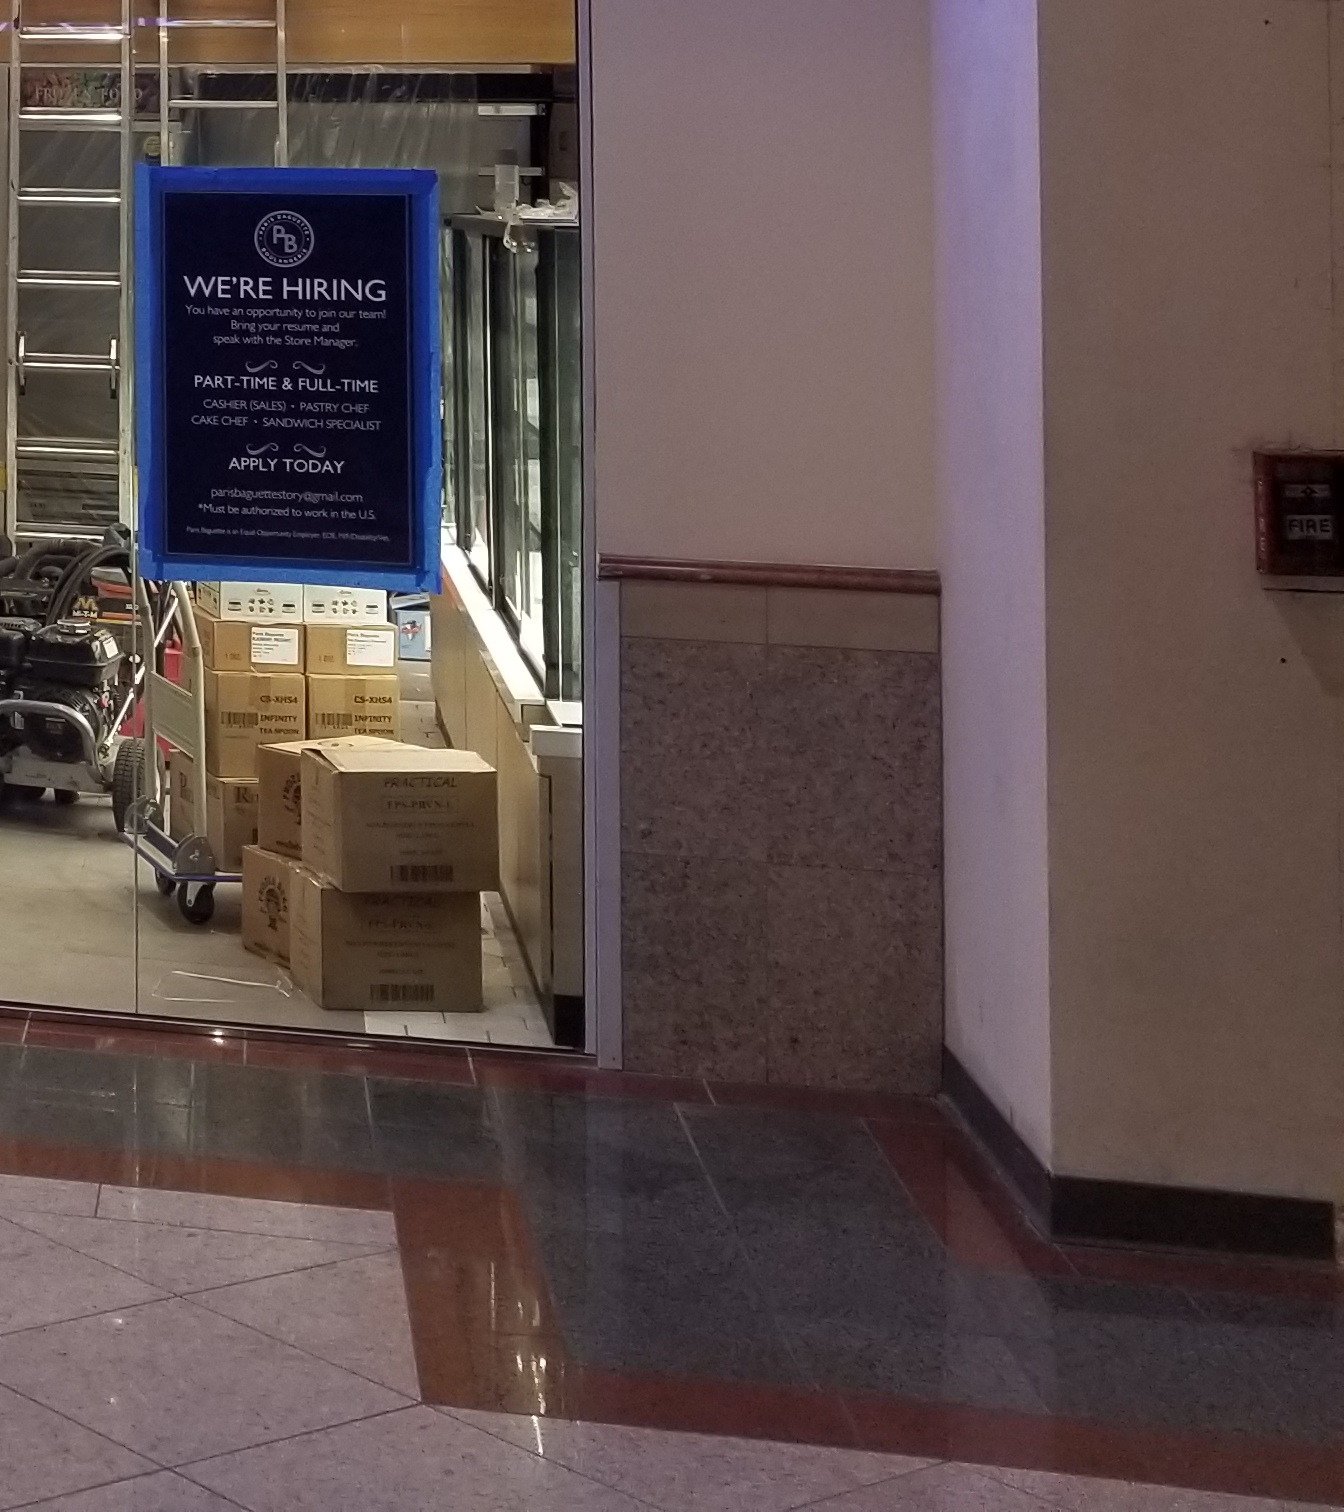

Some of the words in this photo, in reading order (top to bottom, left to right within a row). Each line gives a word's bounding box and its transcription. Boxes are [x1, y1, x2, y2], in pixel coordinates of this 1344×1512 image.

[183, 275, 273, 299] WE'RE
[282, 277, 387, 302] HIRING
[185, 305, 205, 315] You
[207, 305, 230, 316] have
[232, 308, 244, 316] an
[246, 307, 302, 319] opportunity
[305, 309, 316, 318] to
[318, 308, 337, 320] join
[338, 310, 357, 319] our
[358, 309, 387, 319] team!
[230, 319, 256, 333] Bring
[257, 323, 281, 333] your
[283, 323, 320, 332] resume
[321, 322, 340, 332] and
[213, 334, 240, 346] speak
[242, 334, 264, 345] with
[265, 335, 282, 345] the
[284, 335, 312, 346] Store
[313, 336, 358, 349] Manager.
[194, 375, 277, 390] PART-TIME
[281, 377, 294, 391] &
[298, 378, 379, 393] FULL-TIME
[203, 399, 248, 410] CASHIER
[249, 399, 287, 412] (SALES)
[299, 402, 340, 413] PASTRY
[340, 403, 370, 414] CHEF
[191, 415, 219, 425] CAKE
[220, 416, 249, 426] CHEF
[262, 417, 324, 429] SANDWICH
[325, 419, 382, 431] SPECIALIST
[228, 457, 278, 472] APPLY
[281, 459, 345, 474] TODAY
[227, 505, 240, 514] be
[241, 506, 290, 517] authorized
[291, 508, 302, 517] to
[303, 508, 329, 518] work
[330, 509, 339, 518] in
[340, 509, 357, 519] the
[1288, 518, 1331, 534] FIRE
[259, 714, 298, 723] INFINITY
[353, 714, 392, 723] INFINITY
[383, 776, 458, 788] PRACTICAL
